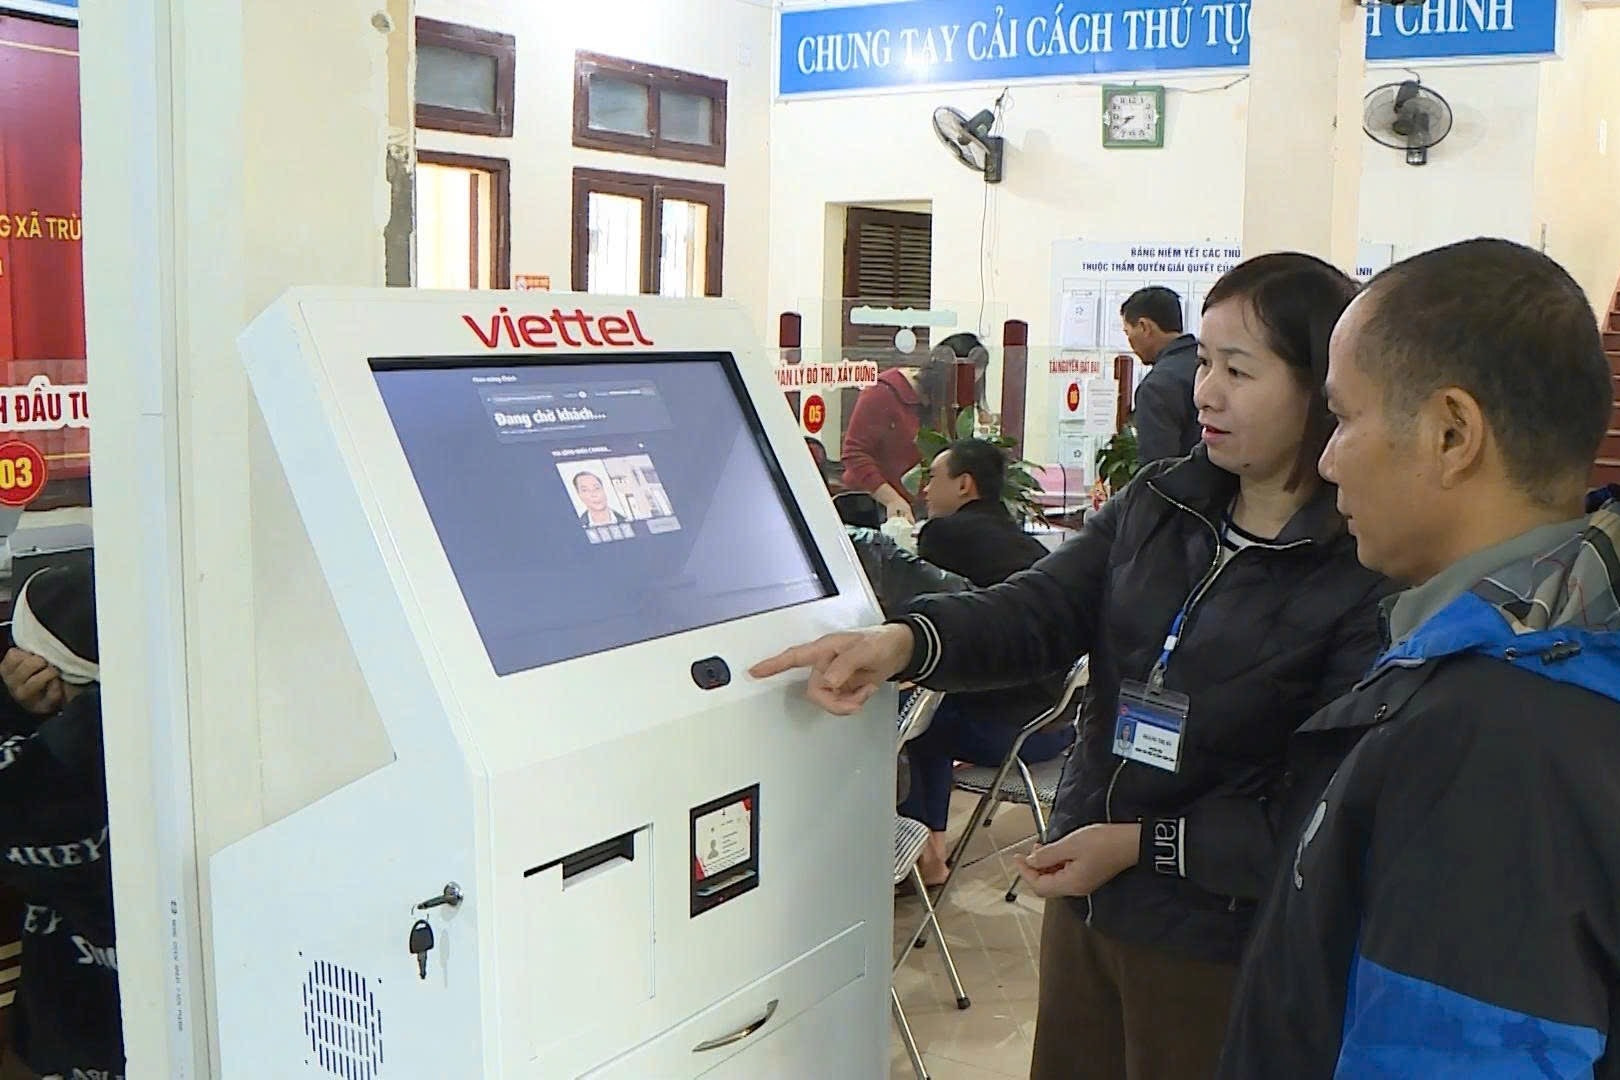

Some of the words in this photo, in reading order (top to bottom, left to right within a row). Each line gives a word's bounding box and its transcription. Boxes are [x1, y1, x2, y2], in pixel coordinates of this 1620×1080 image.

[797, 28, 891, 75] CHUNG
[899, 24, 960, 67] TAY
[967, 5, 1019, 61] CẢI
[1026, 2, 1114, 57] CÁCH
[1201, 2, 1251, 55] TỤ
[14, 211, 42, 238] XÃ
[461, 306, 654, 348] viettel
[15, 383, 62, 422] ĐẦU
[494, 412, 532, 428] Đang
[533, 409, 556, 424] chờ
[809, 405, 821, 424] 05
[0, 457, 33, 489] 03
